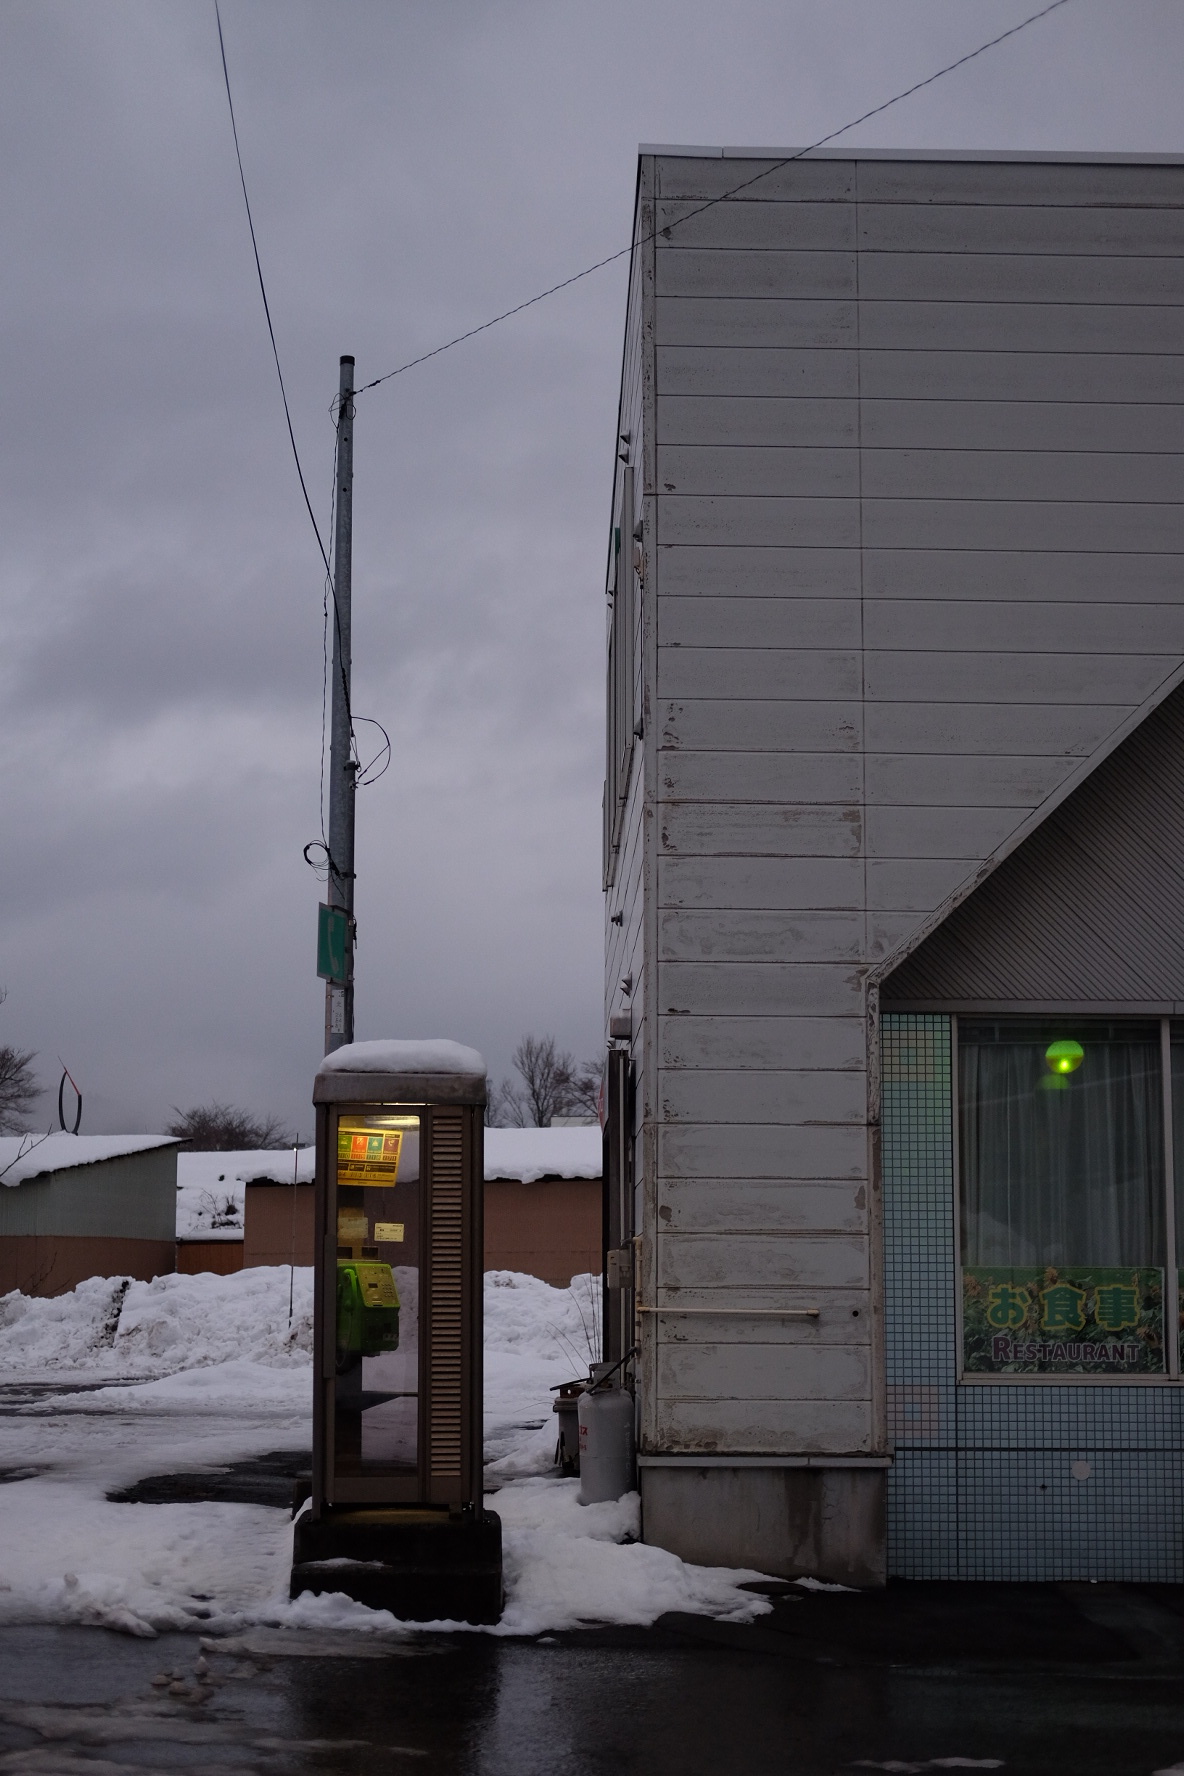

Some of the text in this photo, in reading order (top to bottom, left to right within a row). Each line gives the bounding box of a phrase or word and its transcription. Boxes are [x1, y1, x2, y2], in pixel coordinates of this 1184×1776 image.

[987, 1282, 1141, 1332] お食事
[991, 1336, 1140, 1363] RESTAURANT
